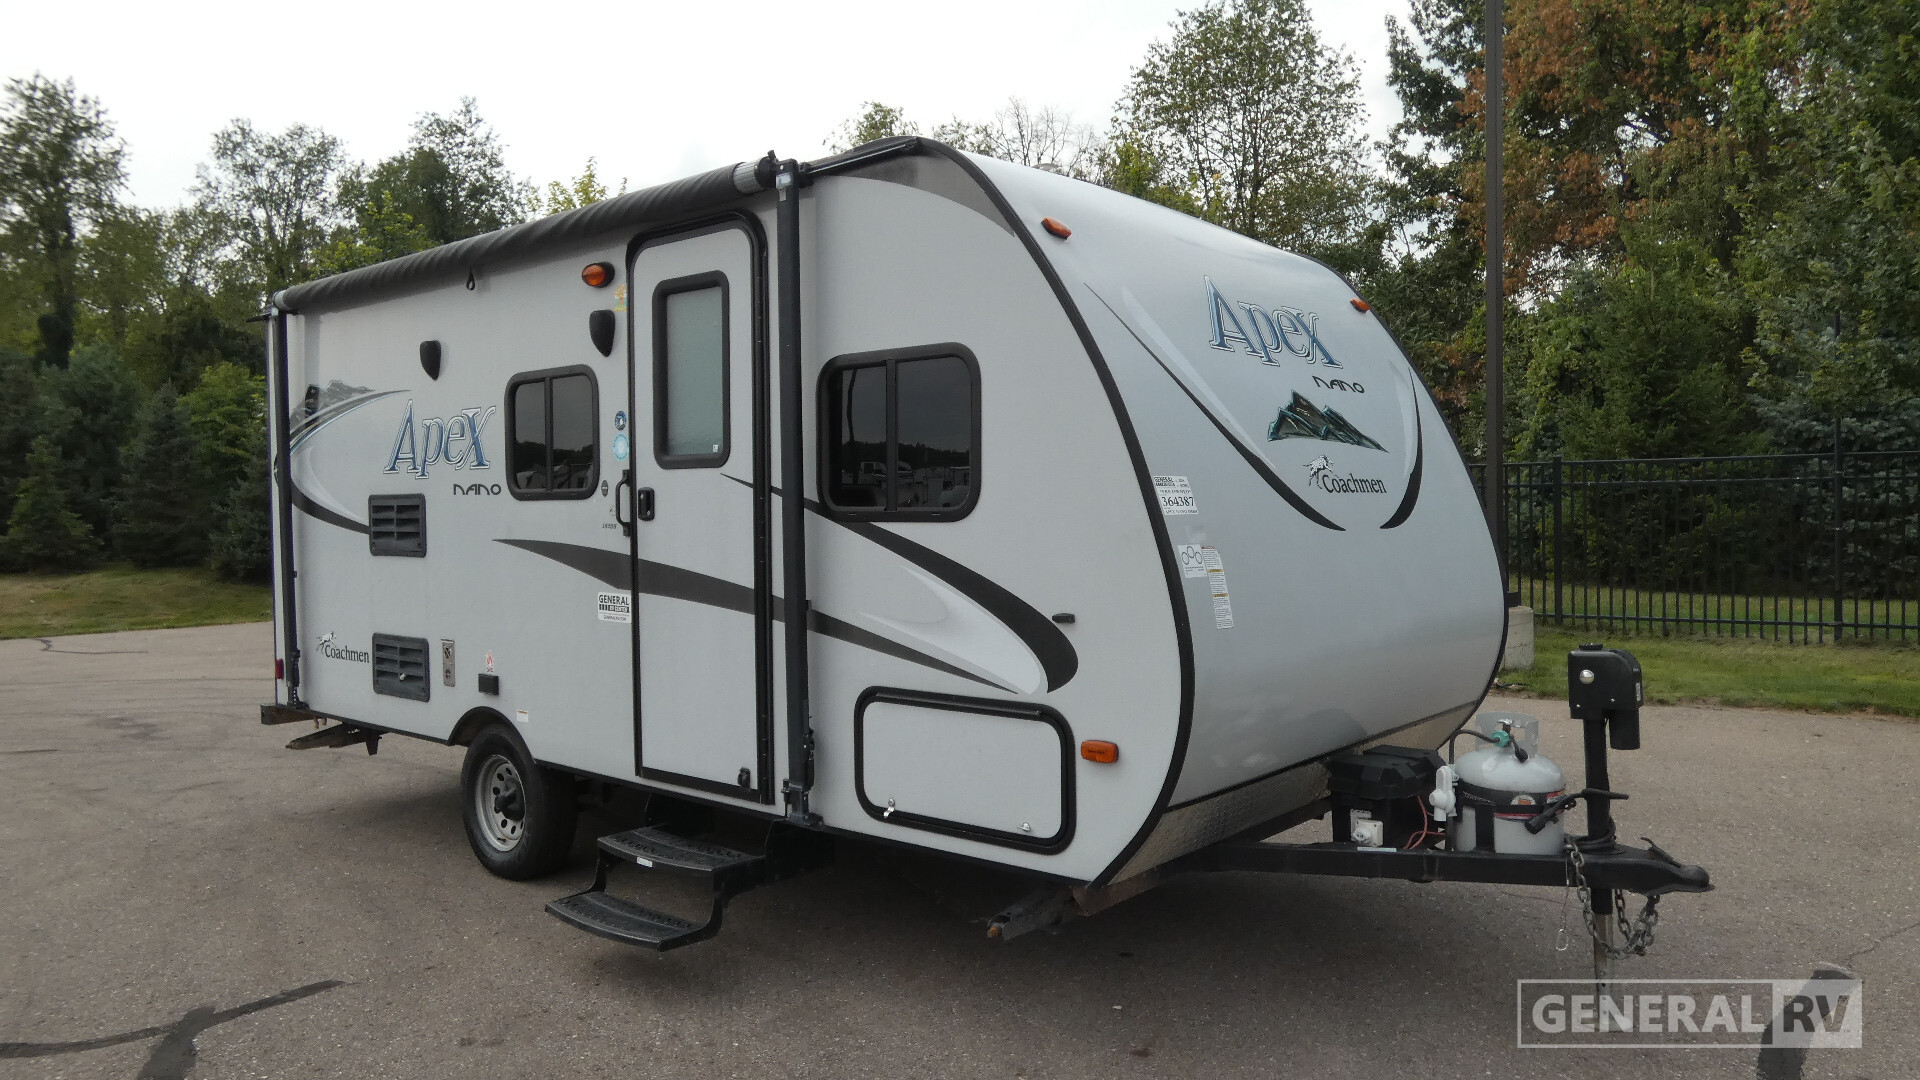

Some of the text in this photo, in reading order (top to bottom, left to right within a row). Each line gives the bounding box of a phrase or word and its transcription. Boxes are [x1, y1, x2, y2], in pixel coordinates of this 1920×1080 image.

[1204, 276, 1343, 369] Apex
[383, 399, 496, 480] Apex
[1322, 473, 1388, 494] Coachmen
[1161, 496, 1194, 507] 364387
[598, 594, 629, 605] GENERAL
[324, 644, 370, 663] Coachmen
